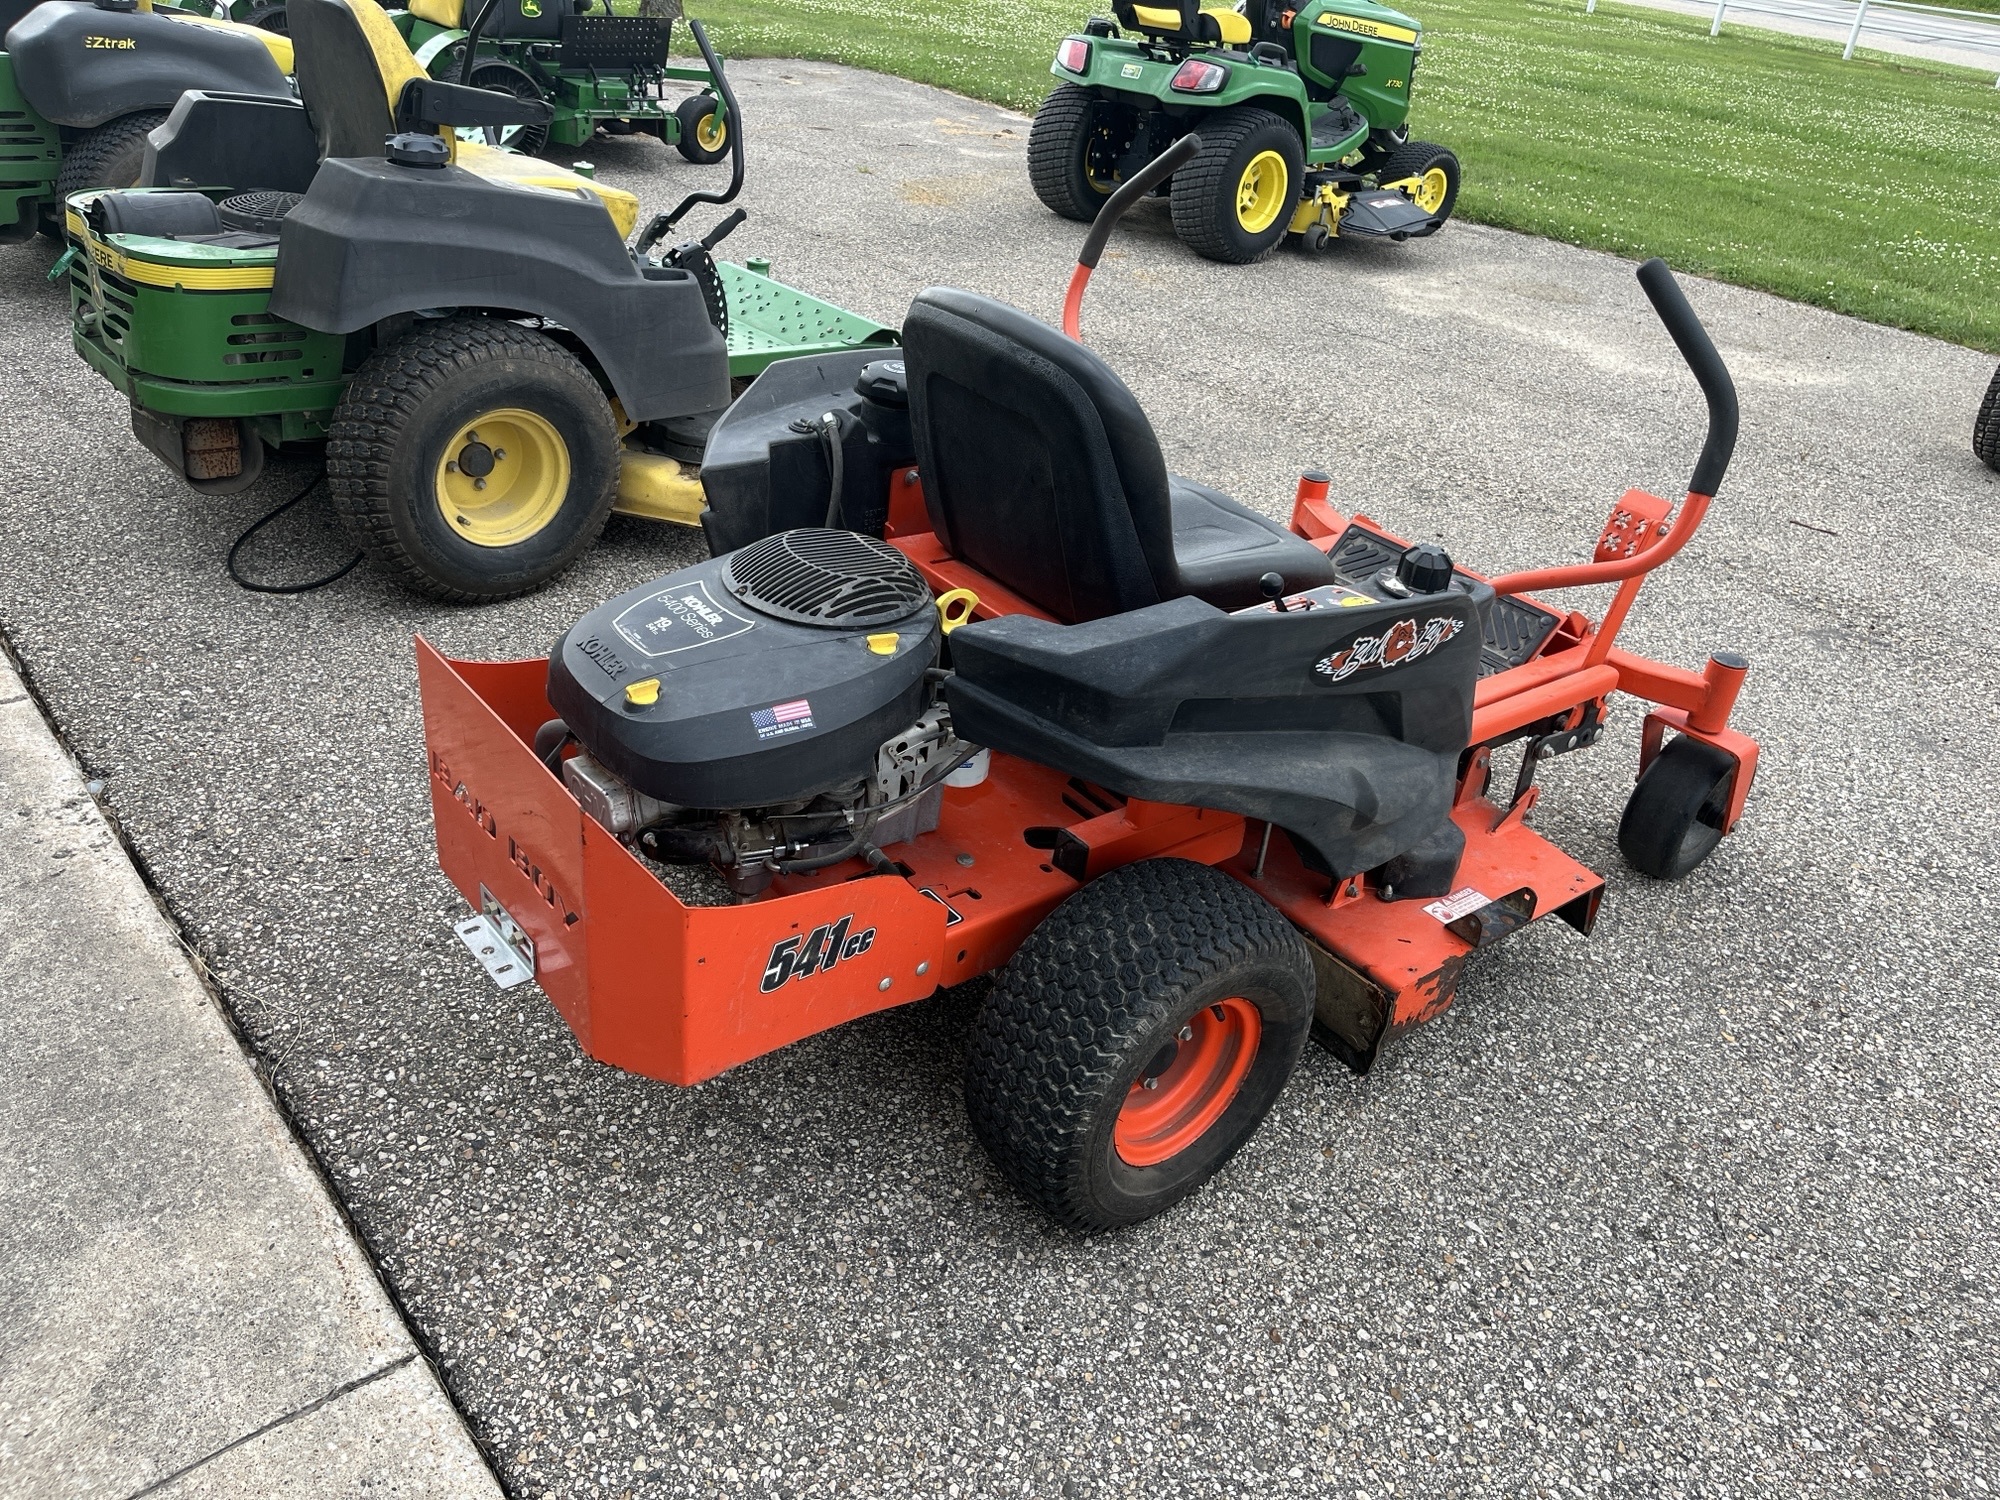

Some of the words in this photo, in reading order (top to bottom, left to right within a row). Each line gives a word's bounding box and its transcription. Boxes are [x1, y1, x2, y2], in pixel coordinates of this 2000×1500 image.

[1326, 15, 1351, 30] JOHN
[1352, 20, 1378, 36] DEERE
[657, 594, 688, 615] 5400
[680, 612, 714, 639] Series
[576, 635, 627, 681] KOHLER
[432, 750, 498, 841] BAD
[508, 834, 580, 932] BOY
